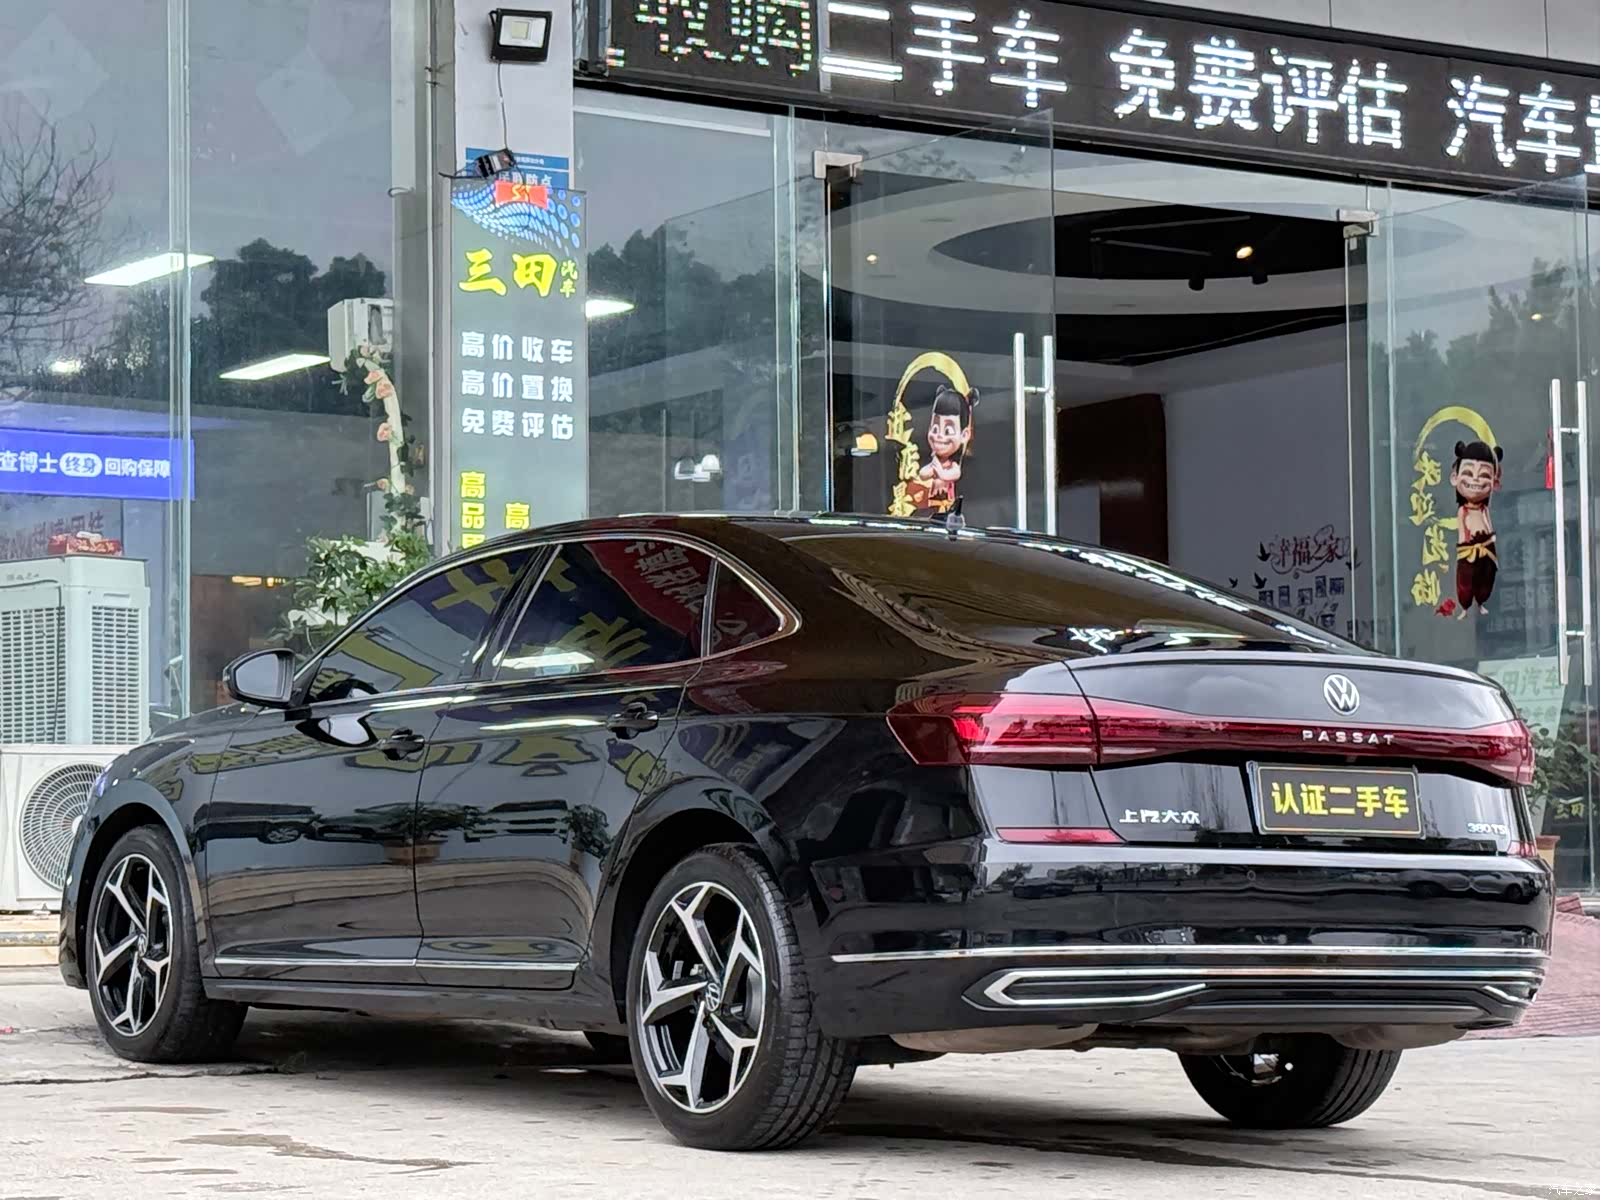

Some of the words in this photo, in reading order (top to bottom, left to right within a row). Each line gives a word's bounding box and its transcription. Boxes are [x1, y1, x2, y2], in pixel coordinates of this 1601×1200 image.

[1110, 28, 1408, 146] 免费评估
[1446, 75, 1600, 174] 汽车
[458, 248, 558, 297] 三田
[560, 259, 579, 298] 汽车
[461, 331, 574, 364] 高价收车
[461, 369, 574, 403] 高价置换
[461, 407, 574, 440] 免费评估
[1409, 451, 1450, 607] 欢迎光临
[1302, 729, 1395, 746] PASSAT
[1119, 809, 1200, 824] 上汽大众
[1271, 782, 1410, 819] 认证二手车
